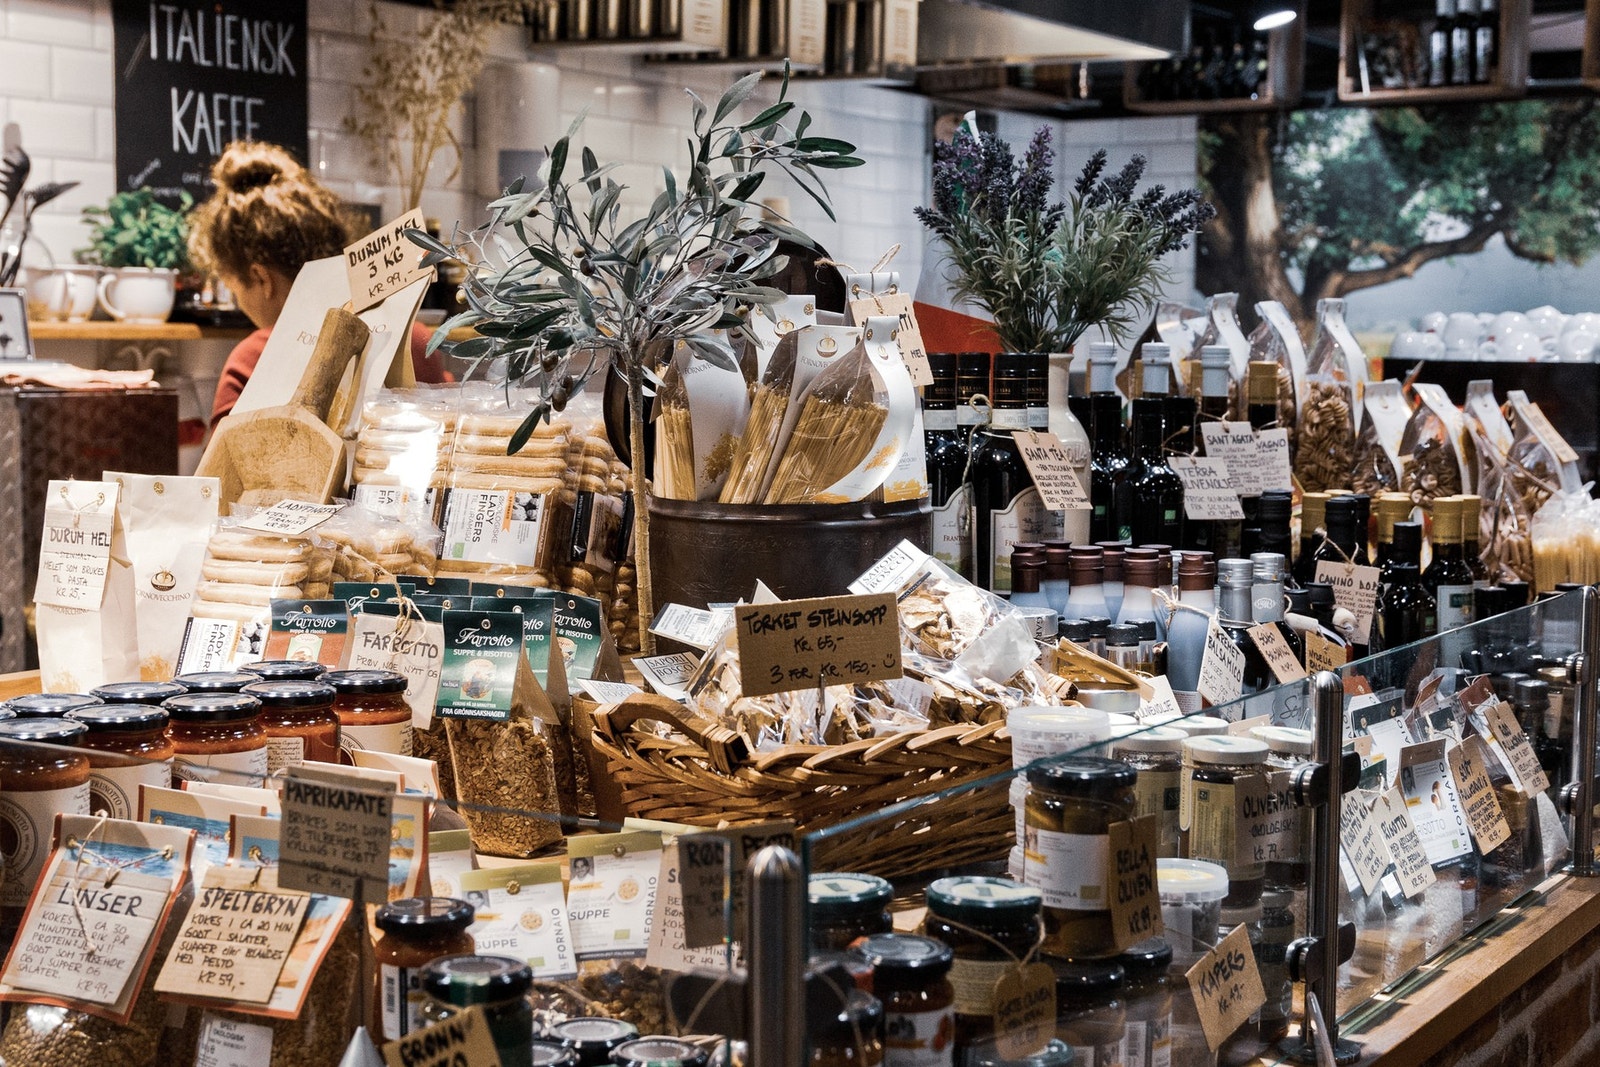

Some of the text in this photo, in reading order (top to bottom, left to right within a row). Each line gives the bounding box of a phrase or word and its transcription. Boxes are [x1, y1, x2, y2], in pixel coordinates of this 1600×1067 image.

[349, 234, 391, 267] DURUM
[367, 246, 403, 278] 3 KG
[369, 283, 384, 298] KR
[1025, 447, 1050, 461] SANTA
[1181, 466, 1217, 477] TERRA
[472, 494, 489, 543] FINGERS
[486, 495, 498, 525] LADY
[50, 527, 85, 545] DURUM
[66, 563, 78, 573] SOM
[81, 566, 105, 576] BRUKES
[52, 575, 88, 587] TIL PASTA
[1319, 573, 1353, 588] CANINO
[56, 587, 66, 597] KR
[742, 611, 802, 636] TORKET
[807, 604, 887, 629] STEINSOPP
[216, 624, 228, 657] LADY
[455, 627, 514, 648] Farrotto
[565, 630, 593, 640] RISOTTO
[817, 635, 844, 653] 65,-
[453, 649, 513, 658] SUPPE & RISOTTO
[647, 655, 684, 667] SAPORI
[1207, 635, 1242, 683] BALSAMICO
[655, 664, 693, 677] BOSCO
[770, 665, 784, 685] 3
[57, 882, 143, 917] LINSER
[200, 887, 302, 917] SPELTGRYN
[644, 876, 657, 933] FORNAIO
[42, 910, 73, 925] KOKES
[114, 925, 128, 935] 30
[191, 913, 223, 927] KOKES
[257, 920, 270, 931] 20
[570, 909, 610, 921] SUPPE
[32, 932, 70, 947] PROTEIN
[77, 941, 104, 952] JEN
[184, 927, 211, 940] GODT
[551, 908, 568, 960] FORNAIO
[179, 940, 218, 955] SUPPER
[475, 938, 517, 950] SUPPE
[56, 948, 75, 960] SOM
[175, 952, 194, 965] MED
[49, 958, 82, 973] SUPPER
[1199, 948, 1246, 1000] KAPERS
